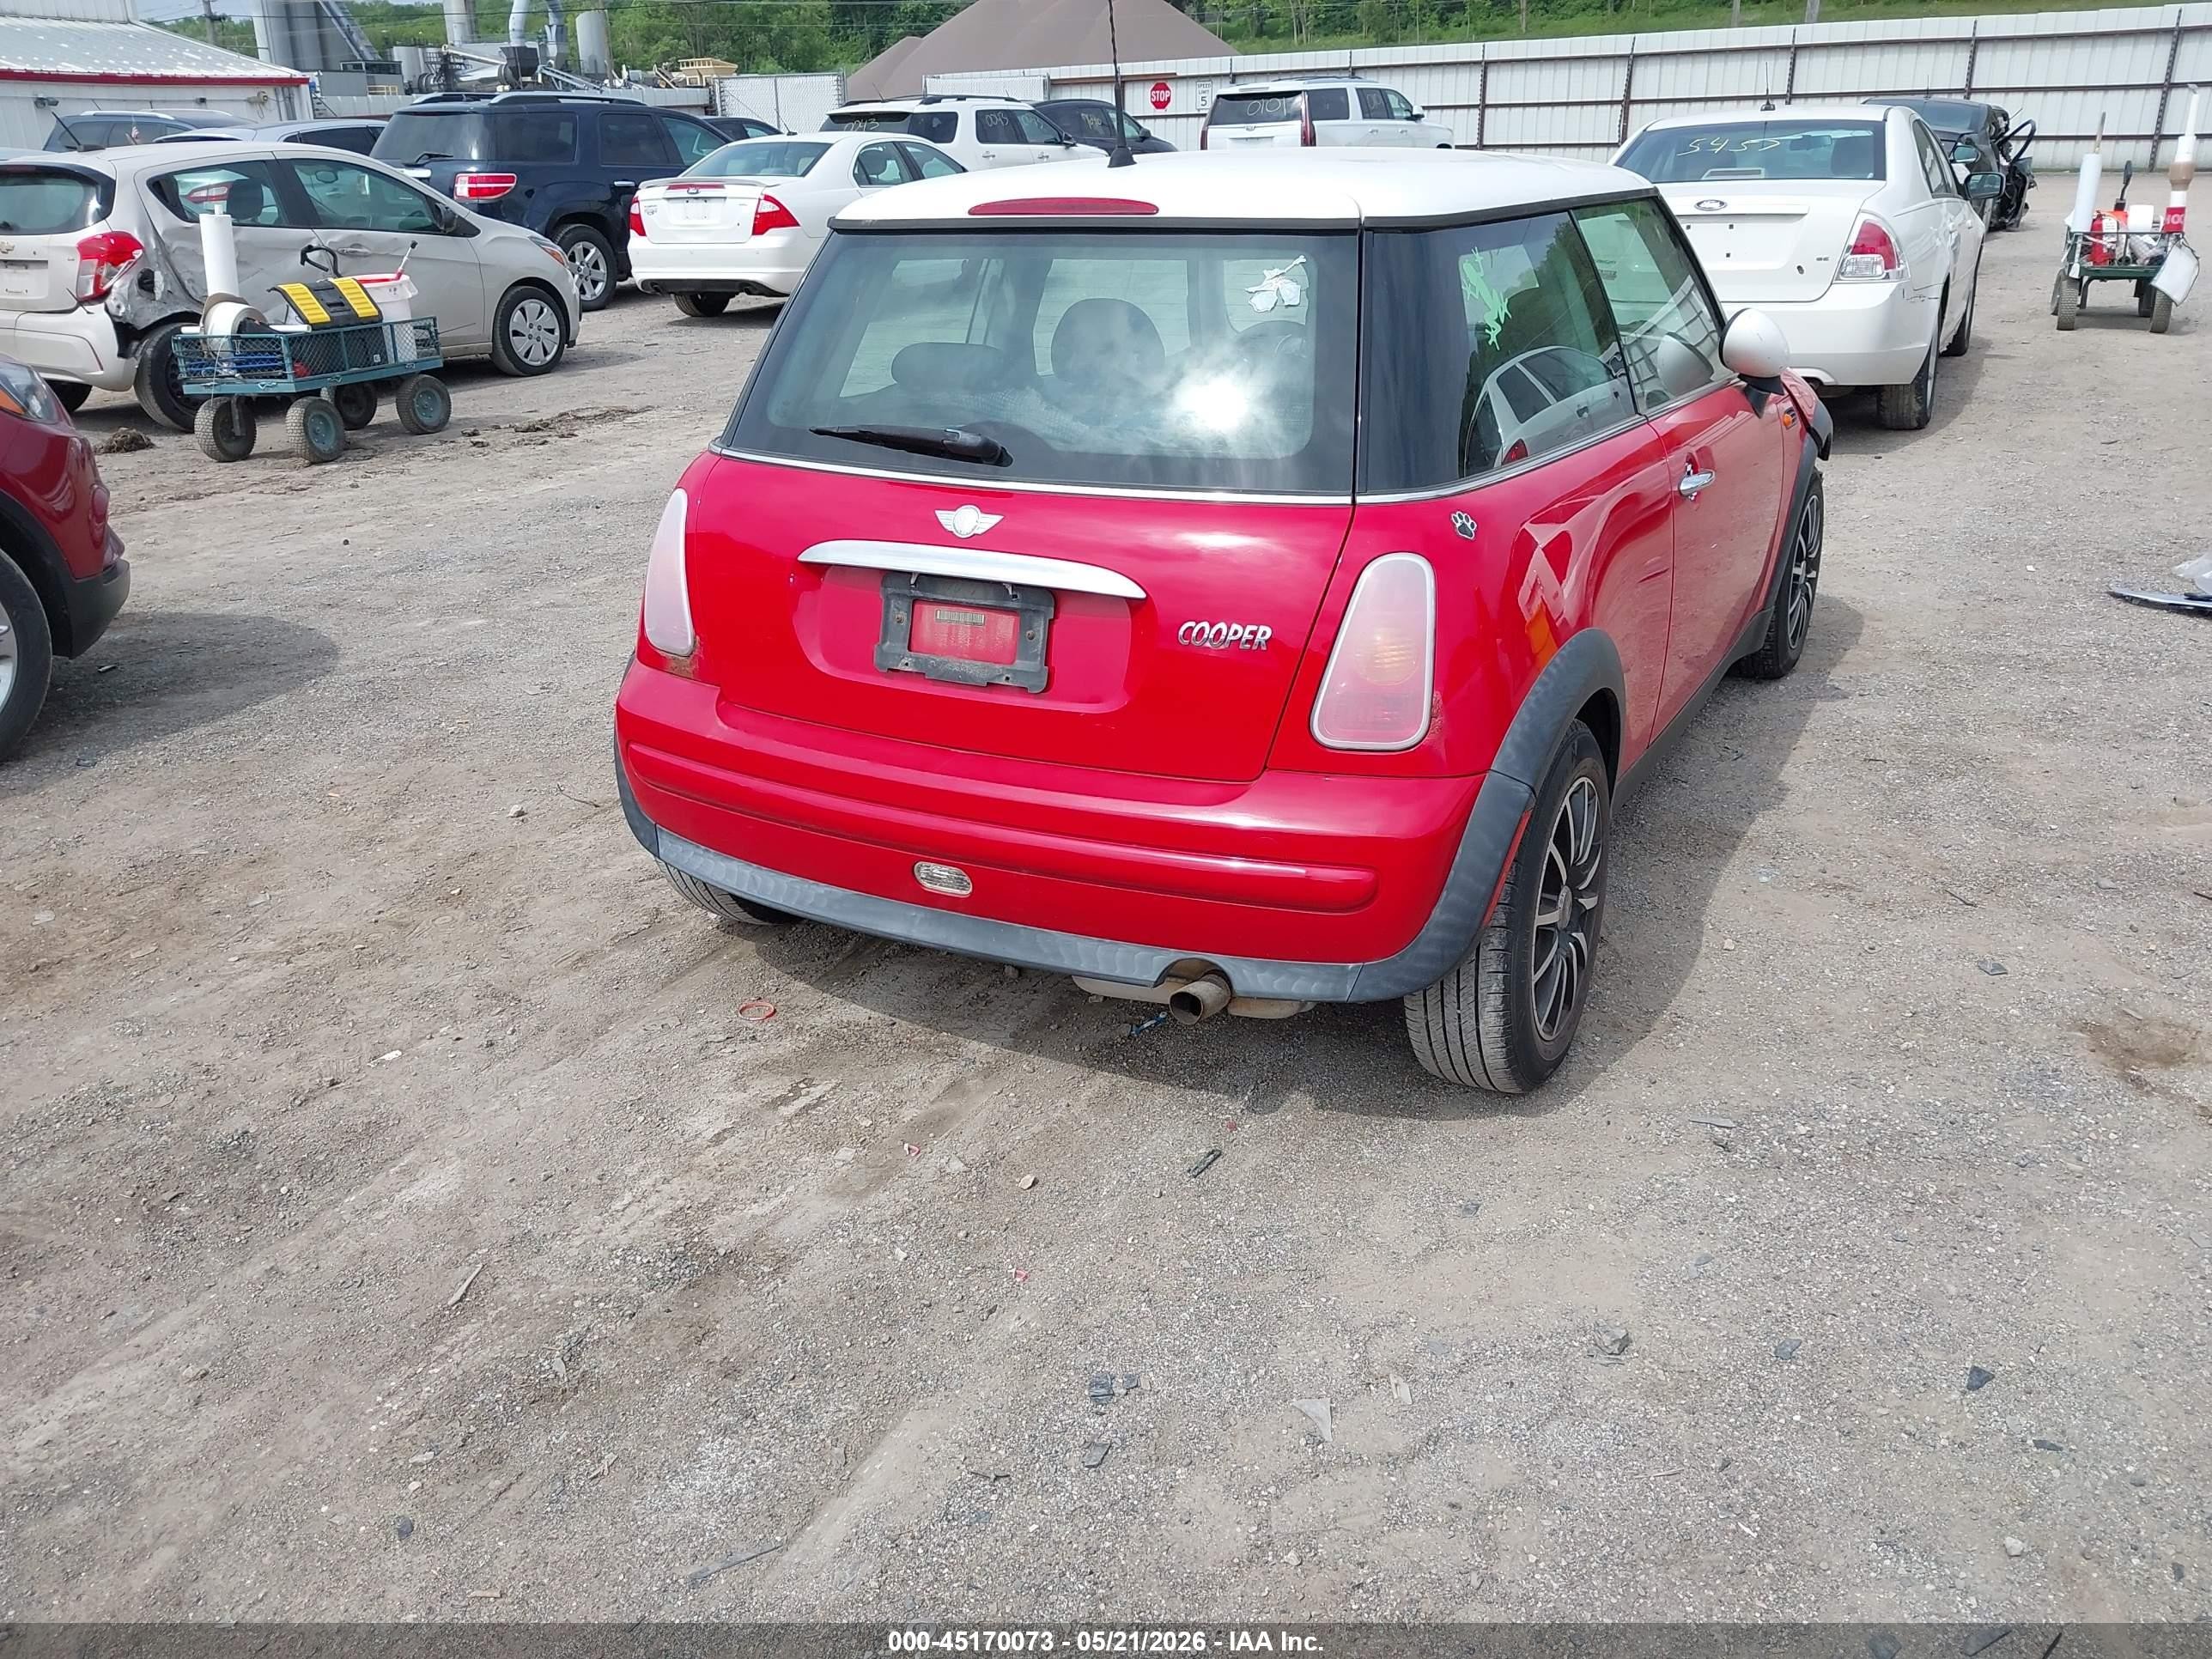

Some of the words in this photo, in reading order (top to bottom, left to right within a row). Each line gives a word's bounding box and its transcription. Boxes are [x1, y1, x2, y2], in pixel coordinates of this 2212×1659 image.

[1151, 90, 1170, 102] STOP
[1200, 95, 1207, 106] 5
[1247, 98, 1287, 117] 0101
[1177, 620, 1273, 651] COOPER
